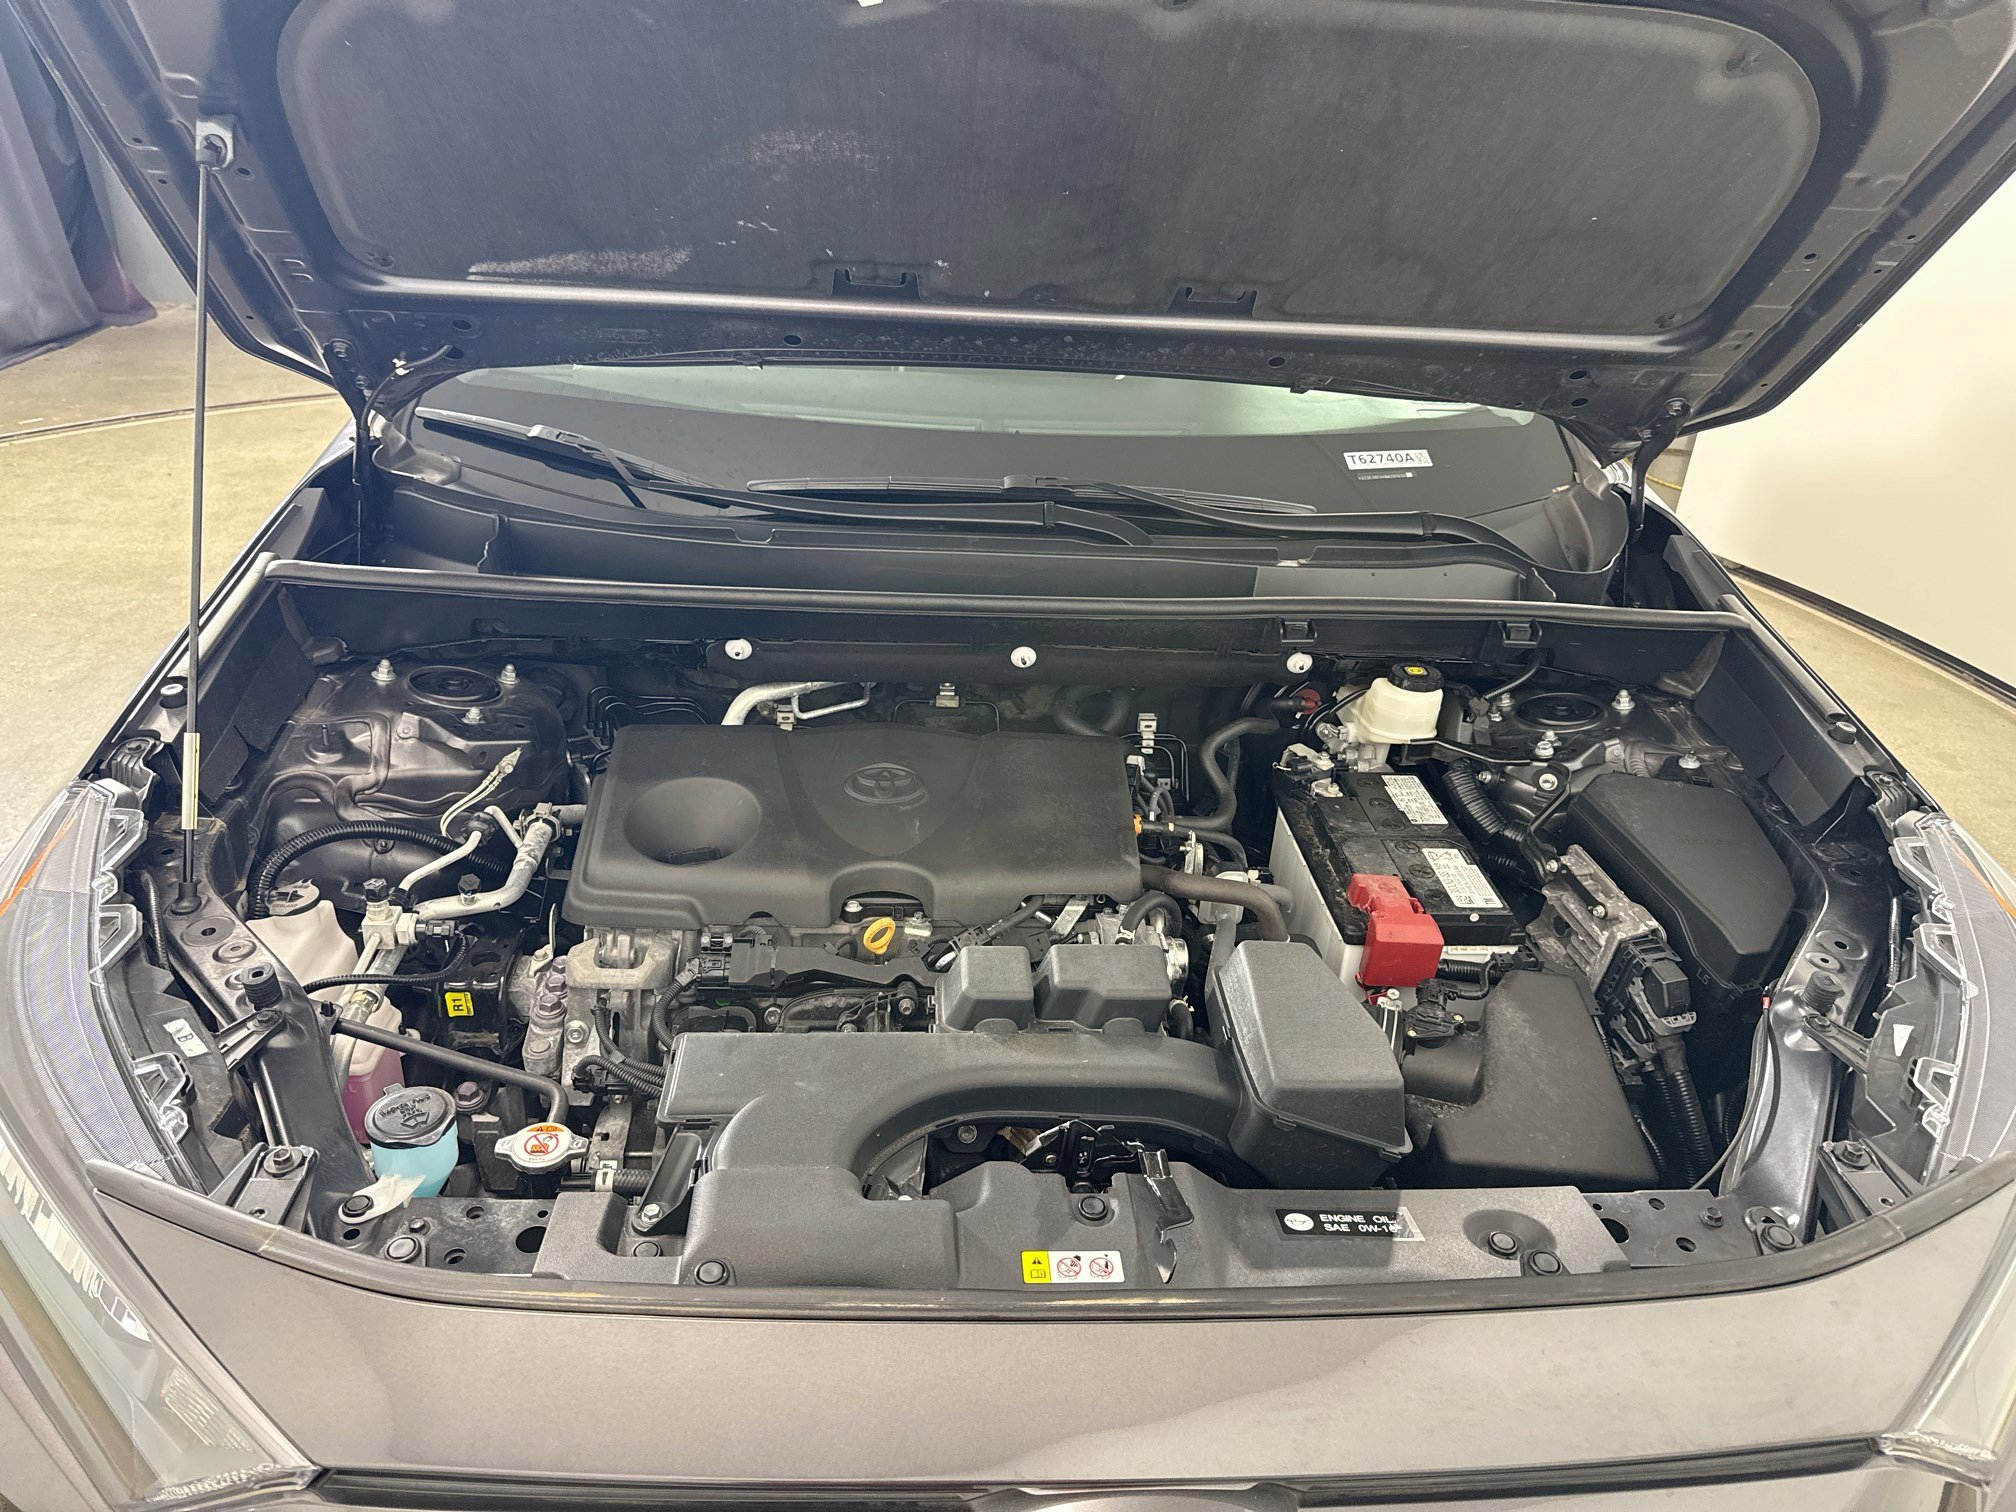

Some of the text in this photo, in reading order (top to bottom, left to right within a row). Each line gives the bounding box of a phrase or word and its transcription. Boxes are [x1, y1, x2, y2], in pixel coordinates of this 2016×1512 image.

[1347, 452, 1415, 465] T62740A
[451, 998, 464, 1012] R1
[1319, 1213, 1395, 1224] ENGINE OIL
[1323, 1223, 1351, 1232] SAE
